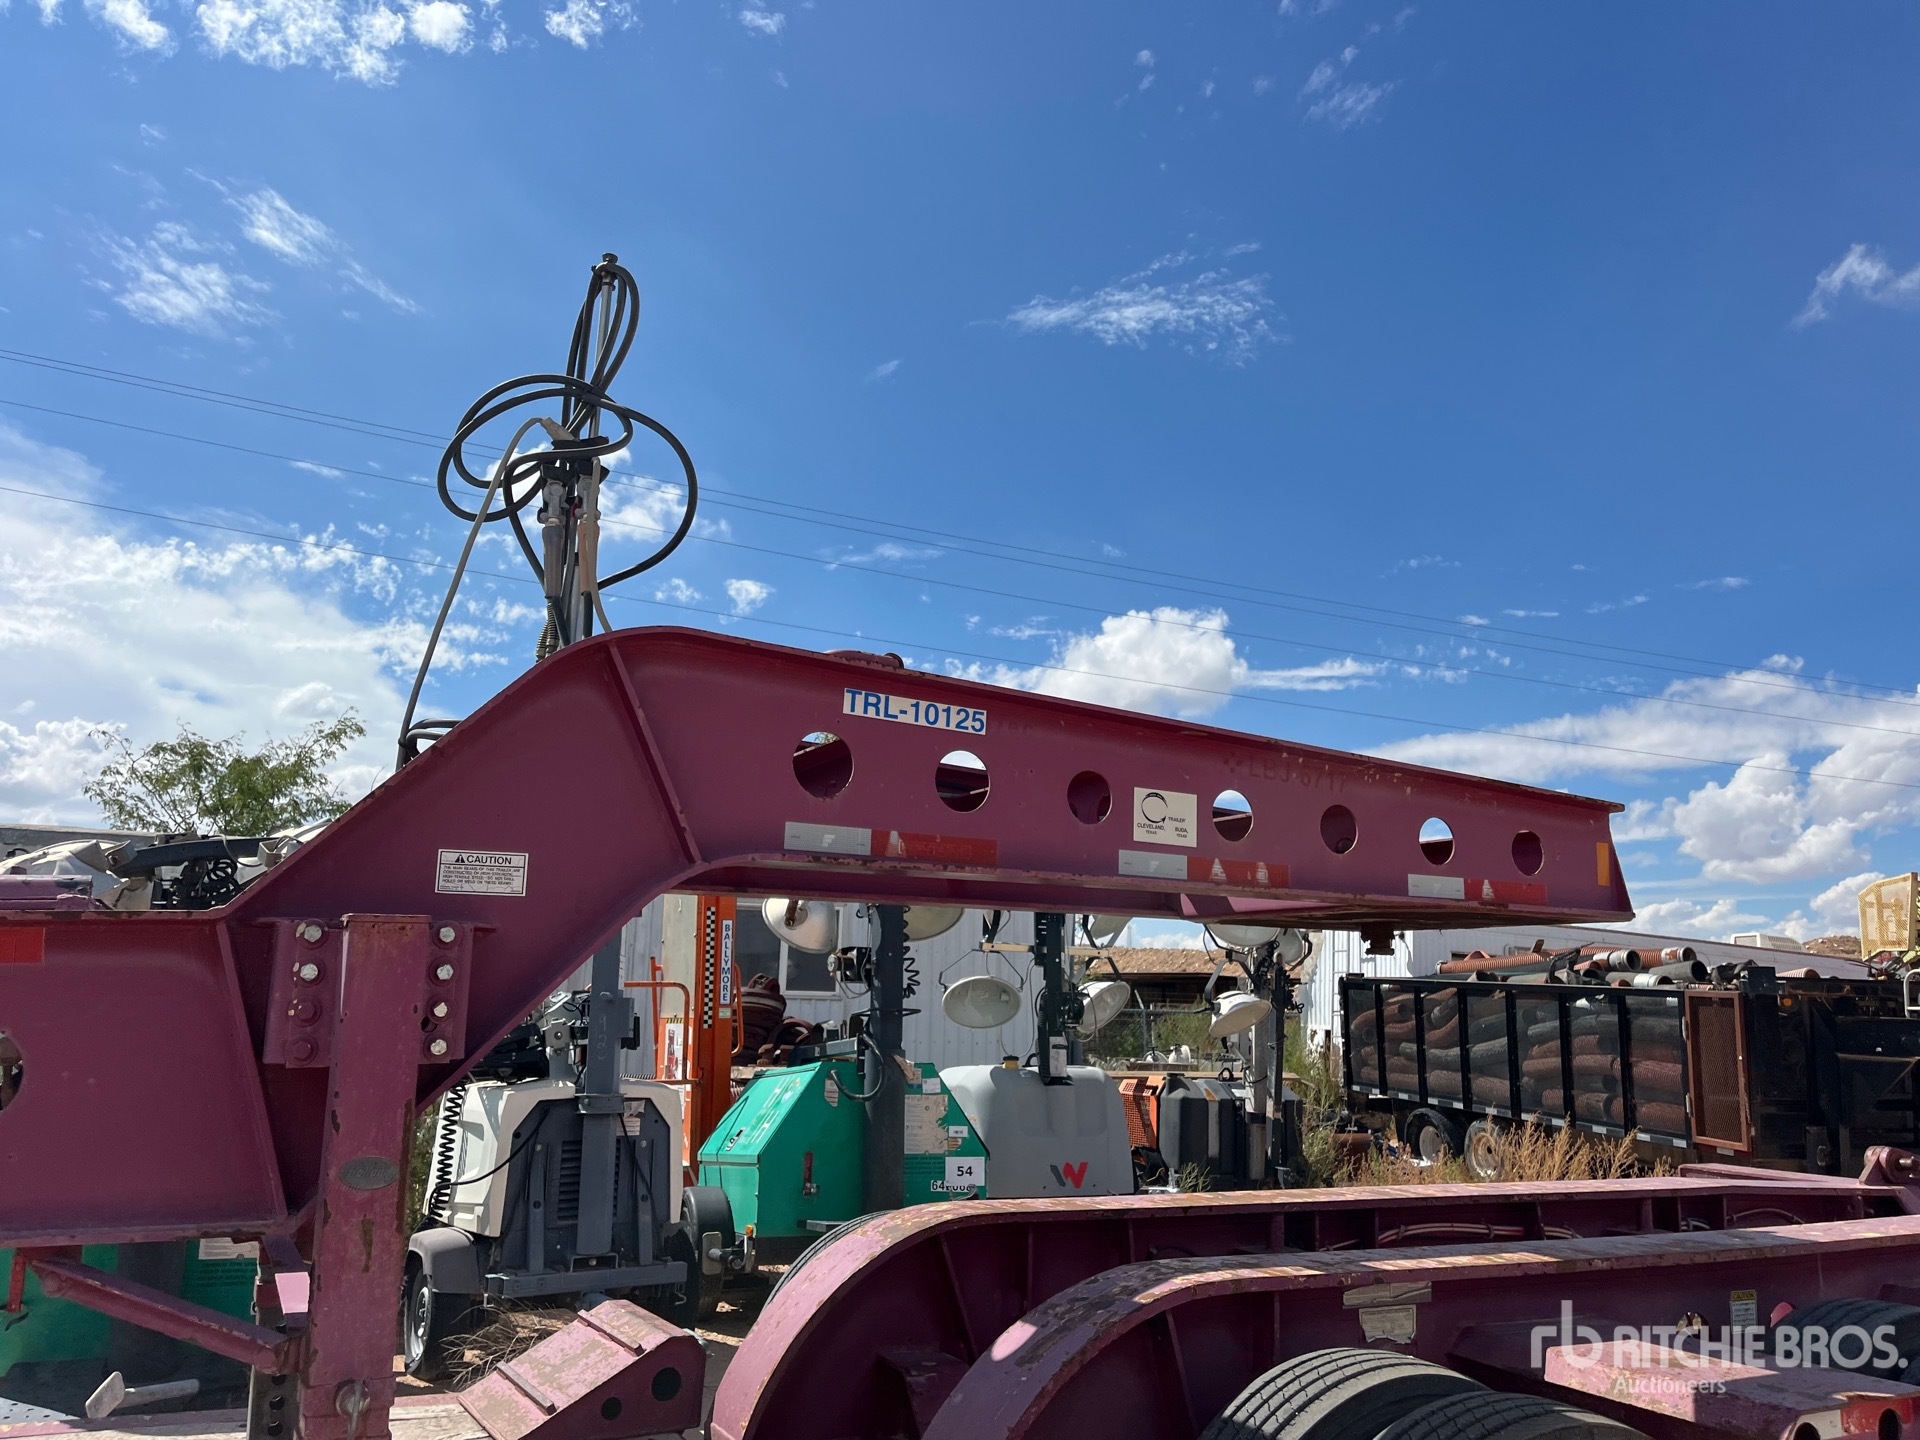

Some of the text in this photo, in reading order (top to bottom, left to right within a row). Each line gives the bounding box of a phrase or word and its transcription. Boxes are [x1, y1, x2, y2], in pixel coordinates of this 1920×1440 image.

[845, 688, 985, 733] TRL-10125
[467, 855, 512, 865] CAUTION
[721, 923, 732, 1002] BALLYMORE
[956, 1166, 973, 1177] 54
